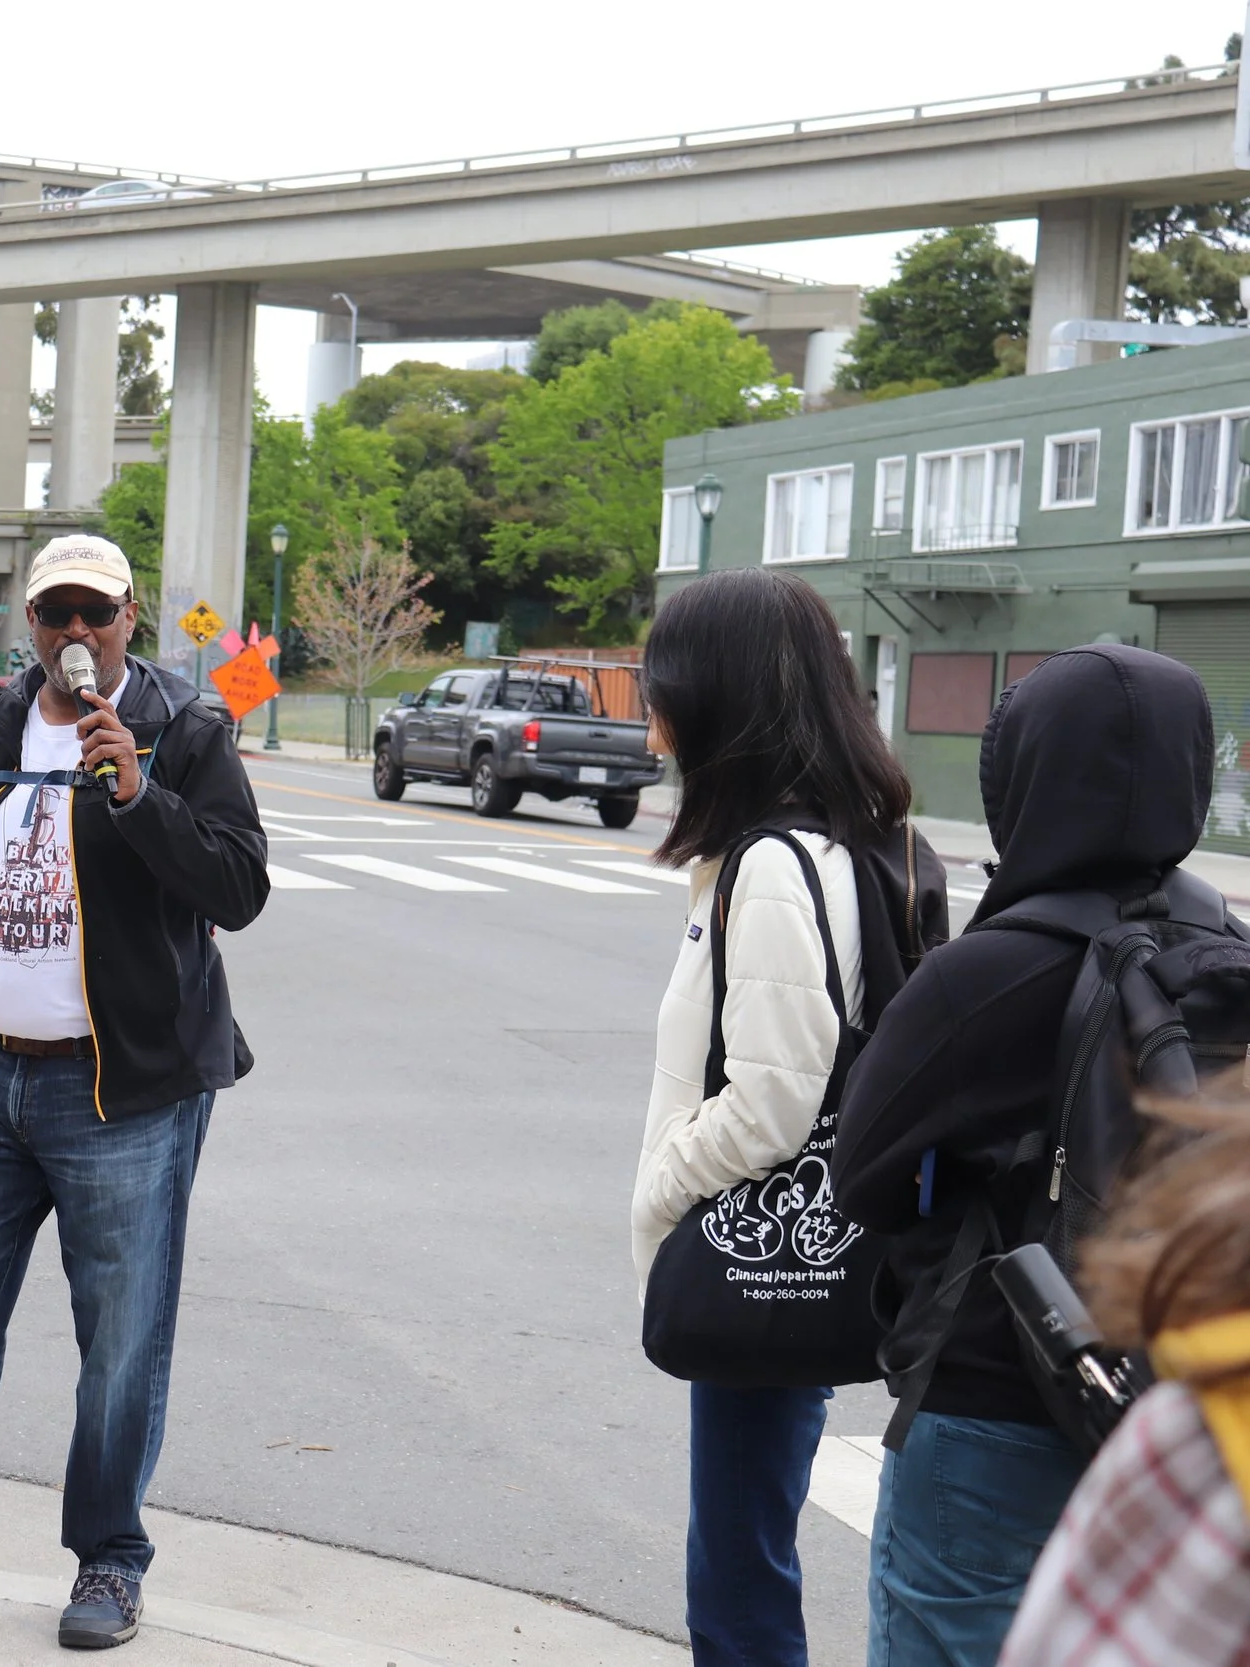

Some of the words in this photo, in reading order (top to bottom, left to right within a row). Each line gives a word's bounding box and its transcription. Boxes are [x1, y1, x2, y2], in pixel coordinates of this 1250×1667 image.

[233, 661, 262, 677] ROAD
[231, 675, 259, 688] WORK
[0, 920, 64, 939] TOUR
[726, 1267, 772, 1283] Clinical
[774, 1267, 846, 1283] Department
[742, 1288, 829, 1299] 1-800-260-0094
